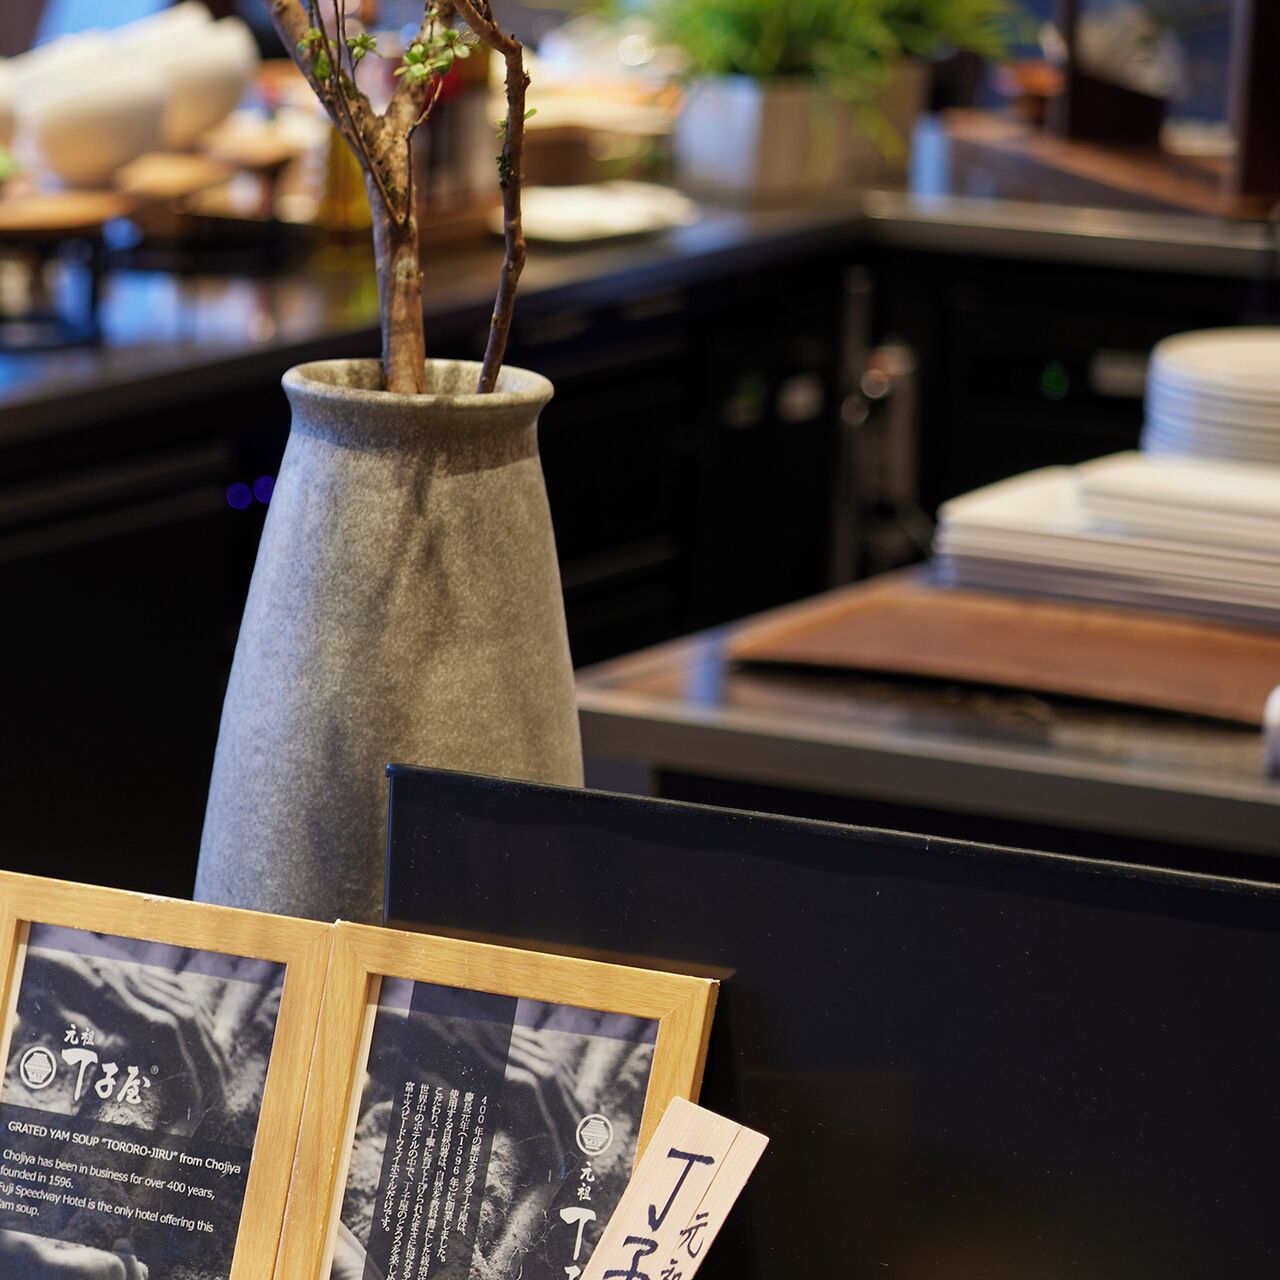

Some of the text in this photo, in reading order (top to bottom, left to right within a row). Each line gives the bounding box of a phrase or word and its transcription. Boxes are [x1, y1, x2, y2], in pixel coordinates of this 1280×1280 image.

[64, 1023, 95, 1046] 元祖
[61, 1048, 151, 1105] 丁子屋
[8, 1120, 48, 1137] GRATED
[49, 1128, 70, 1142] YAM
[71, 1132, 100, 1147] SOUP
[179, 1152, 203, 1167] from
[205, 1157, 241, 1175] Chojiya
[0, 1165, 74, 1189] founded in 1596.
[2, 1148, 215, 1200] Chojiya has been in business for over 400 years,
[577, 1161, 596, 1201] 元祖
[14, 1184, 61, 1205] Speedway
[62, 1194, 87, 1208] Hotel
[87, 1198, 97, 1210] is
[97, 1200, 113, 1213] the
[113, 1205, 134, 1220] only
[134, 1207, 159, 1222] hotel
[159, 1213, 196, 1232] offering
[196, 1220, 214, 1233] this
[15, 1203, 40, 1218] soup.
